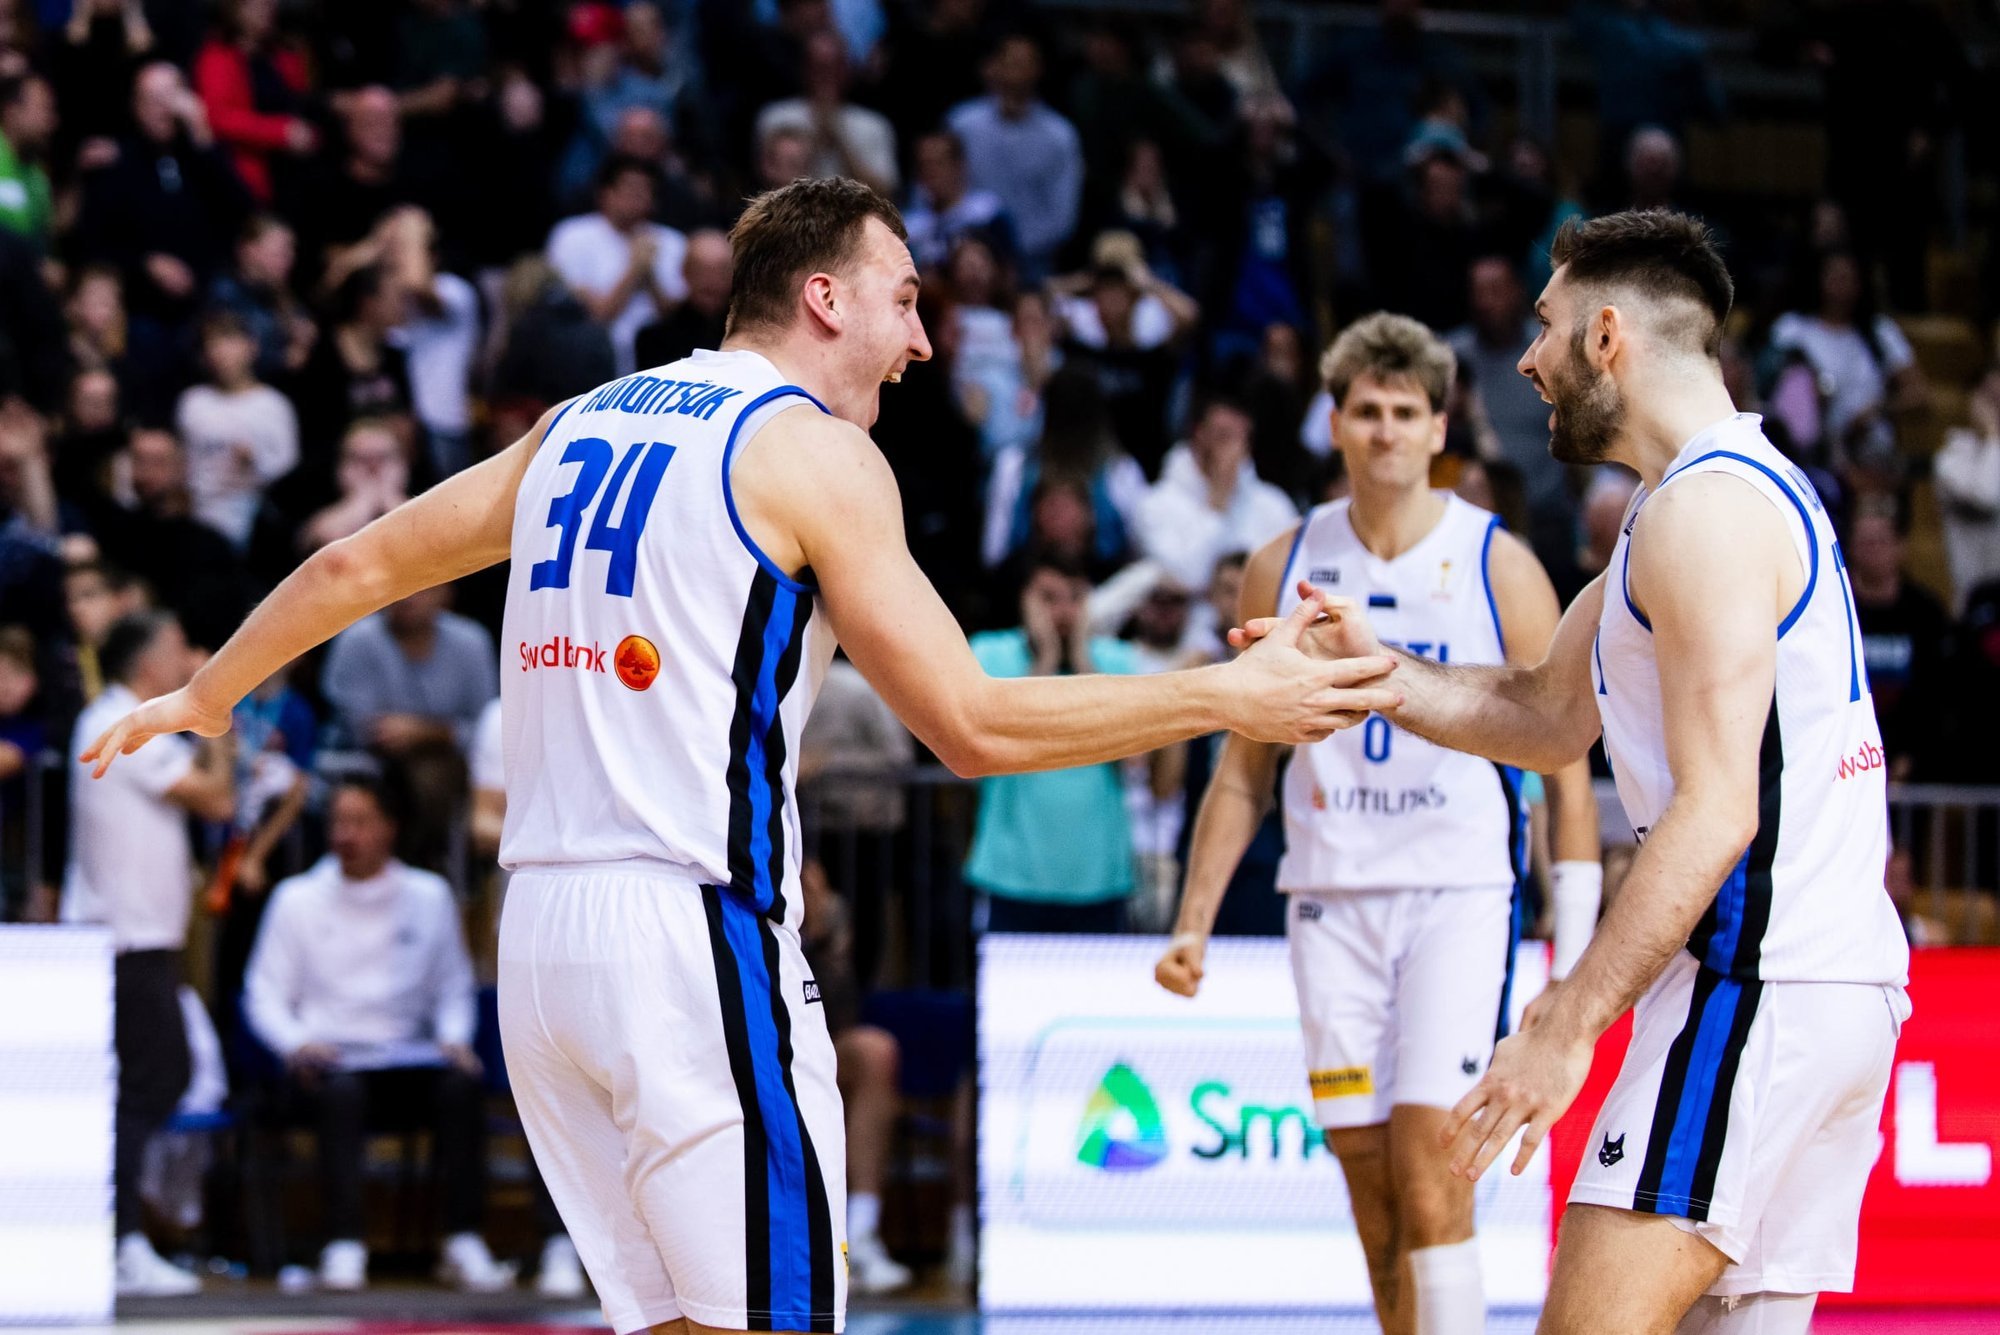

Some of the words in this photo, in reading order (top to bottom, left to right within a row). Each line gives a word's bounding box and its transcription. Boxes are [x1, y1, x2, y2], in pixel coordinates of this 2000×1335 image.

[530, 437, 677, 598] 34
[1364, 715, 1391, 763] 0
[1190, 1082, 1336, 1161] Sm
